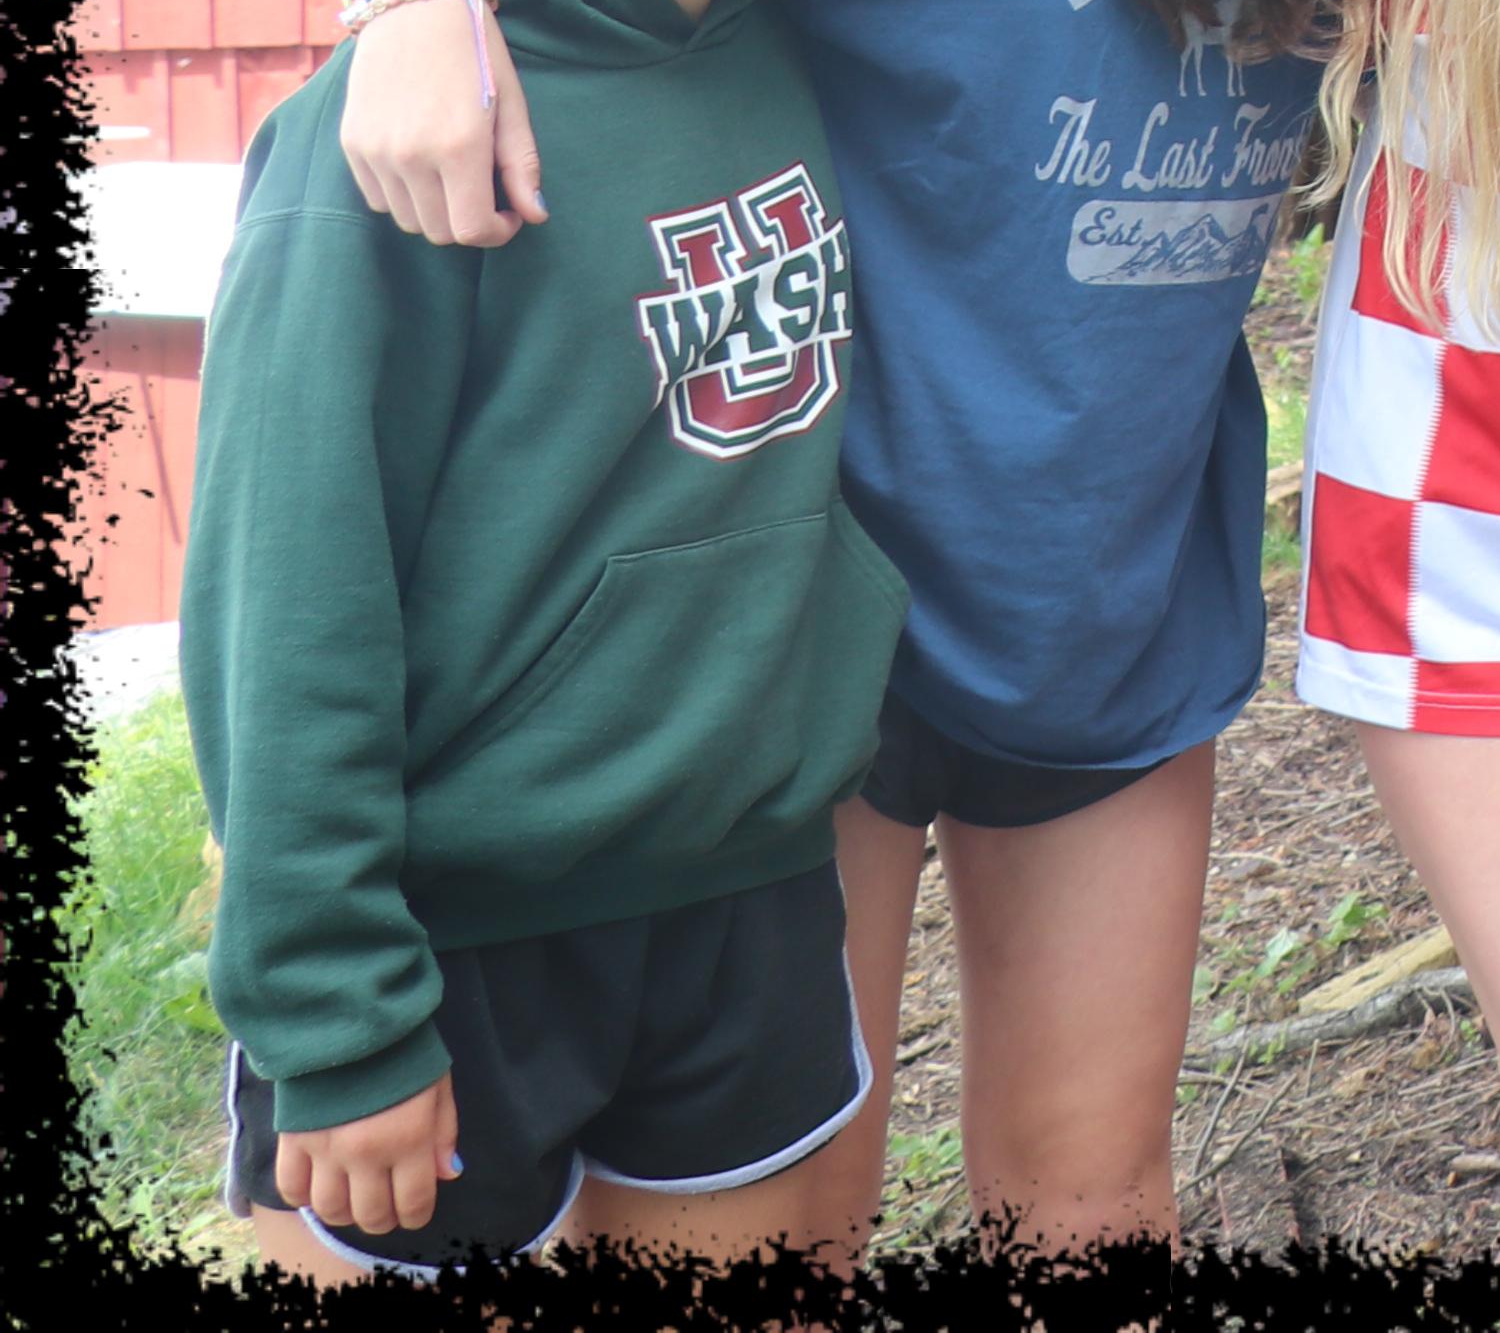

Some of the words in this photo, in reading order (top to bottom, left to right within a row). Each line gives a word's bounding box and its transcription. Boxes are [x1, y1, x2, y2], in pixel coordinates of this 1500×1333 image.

[1034, 95, 1111, 189] The
[1121, 101, 1219, 193] Last
[635, 218, 854, 388] WASH
